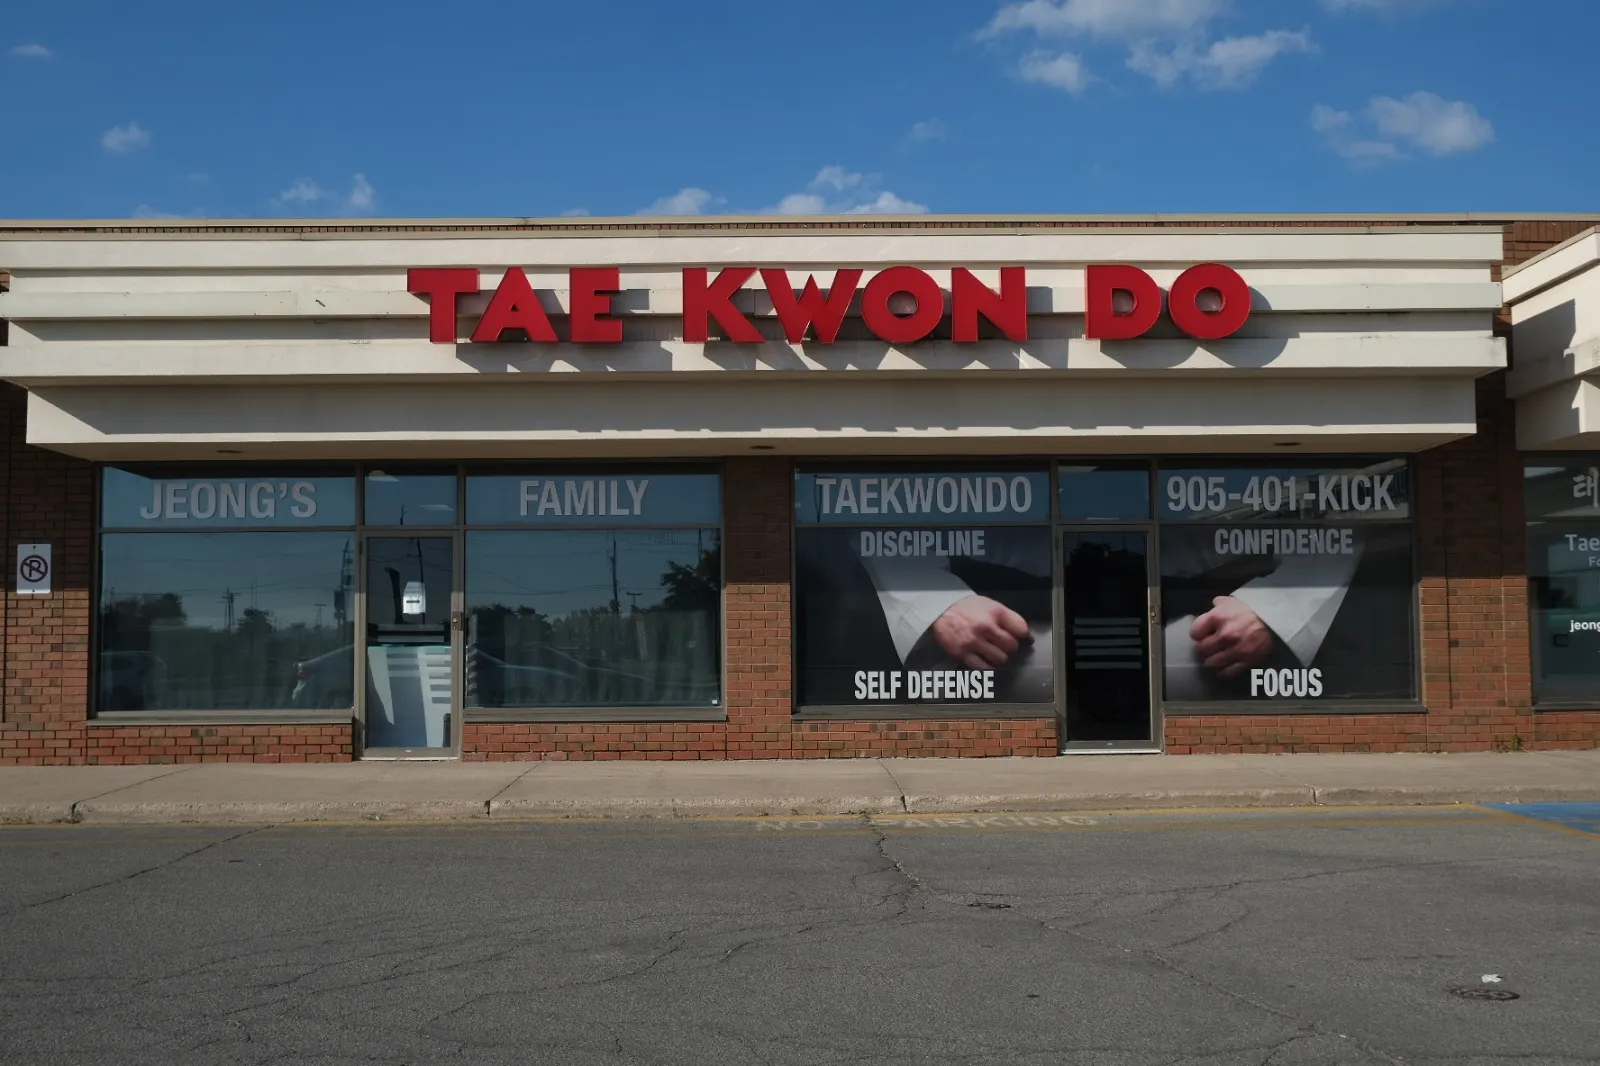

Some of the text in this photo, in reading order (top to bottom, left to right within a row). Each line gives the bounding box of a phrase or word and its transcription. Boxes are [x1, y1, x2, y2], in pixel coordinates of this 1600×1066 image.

[407, 263, 1252, 344] TAE KWON DO
[140, 481, 317, 520] JEONG'S
[520, 480, 648, 516] FAMILY
[818, 476, 1031, 513] TAEKWONDO
[1167, 474, 1395, 512] 905-401-KICK
[860, 530, 985, 557] DISCIPLINE
[1214, 528, 1354, 555] CONFIDENCE
[1565, 534, 1600, 551] Tae
[854, 670, 995, 699] SELF DEFENSE
[1250, 668, 1323, 697] FOCUS
